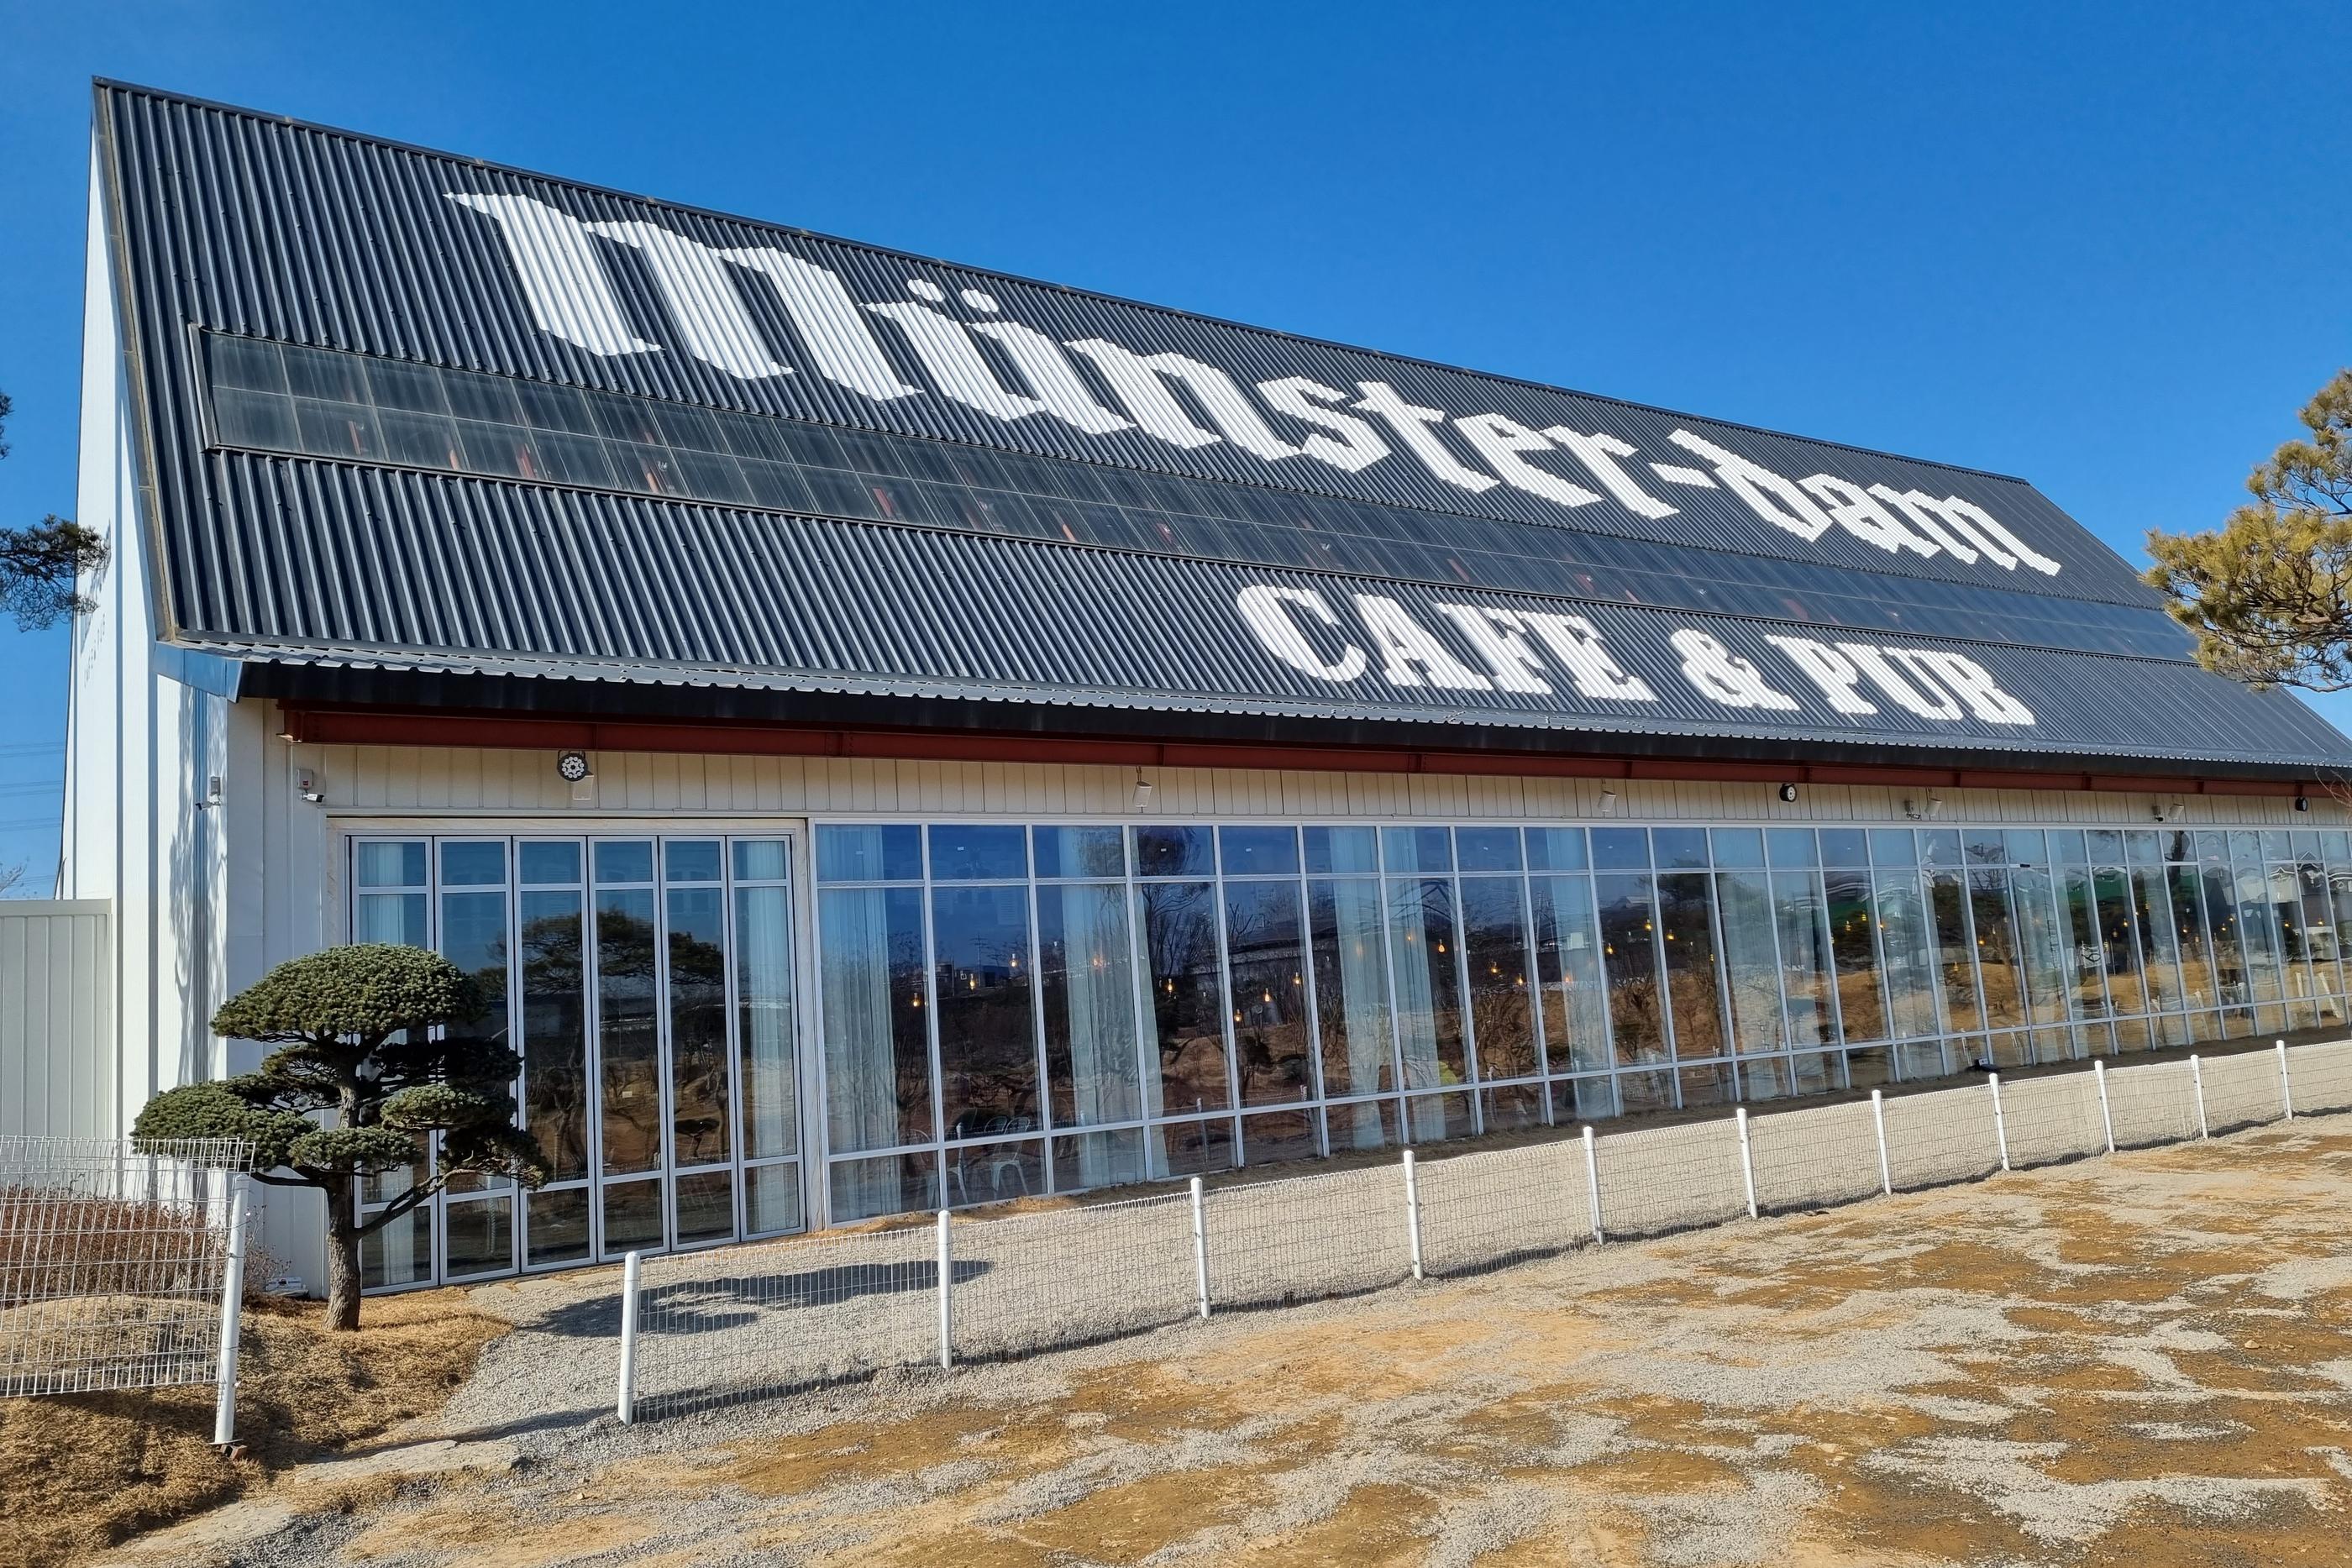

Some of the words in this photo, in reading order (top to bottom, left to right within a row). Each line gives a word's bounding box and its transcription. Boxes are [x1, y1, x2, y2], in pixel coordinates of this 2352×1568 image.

[1237, 585, 1657, 702] CAFE
[1671, 628, 1800, 712] &
[1765, 634, 2036, 726] PUB
